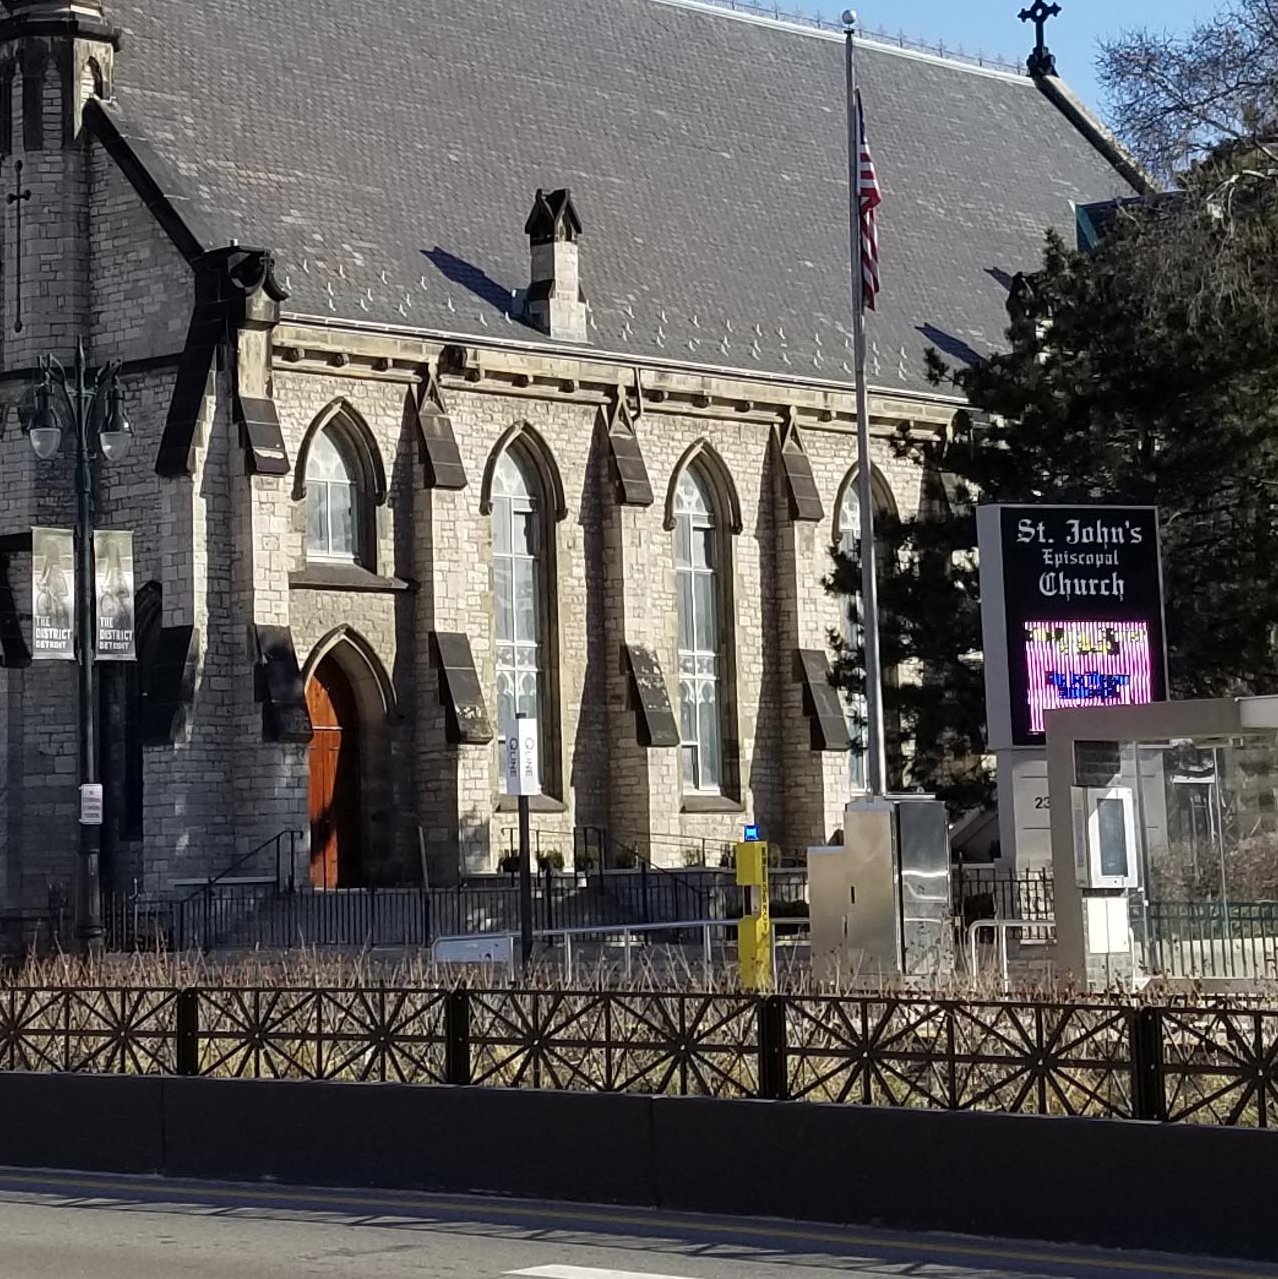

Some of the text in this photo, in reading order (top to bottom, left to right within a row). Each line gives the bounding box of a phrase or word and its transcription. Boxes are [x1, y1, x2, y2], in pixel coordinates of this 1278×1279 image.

[1016, 518, 1143, 549] St. John's
[1042, 548, 1119, 568] Episcopal
[1039, 572, 1125, 602] Church
[35, 615, 50, 627] THE
[99, 616, 113, 628] THE
[35, 628, 71, 640] DISTRICT
[99, 629, 133, 641] DISTRICT
[35, 640, 66, 649] DETROIT
[99, 641, 129, 650] DETROIT
